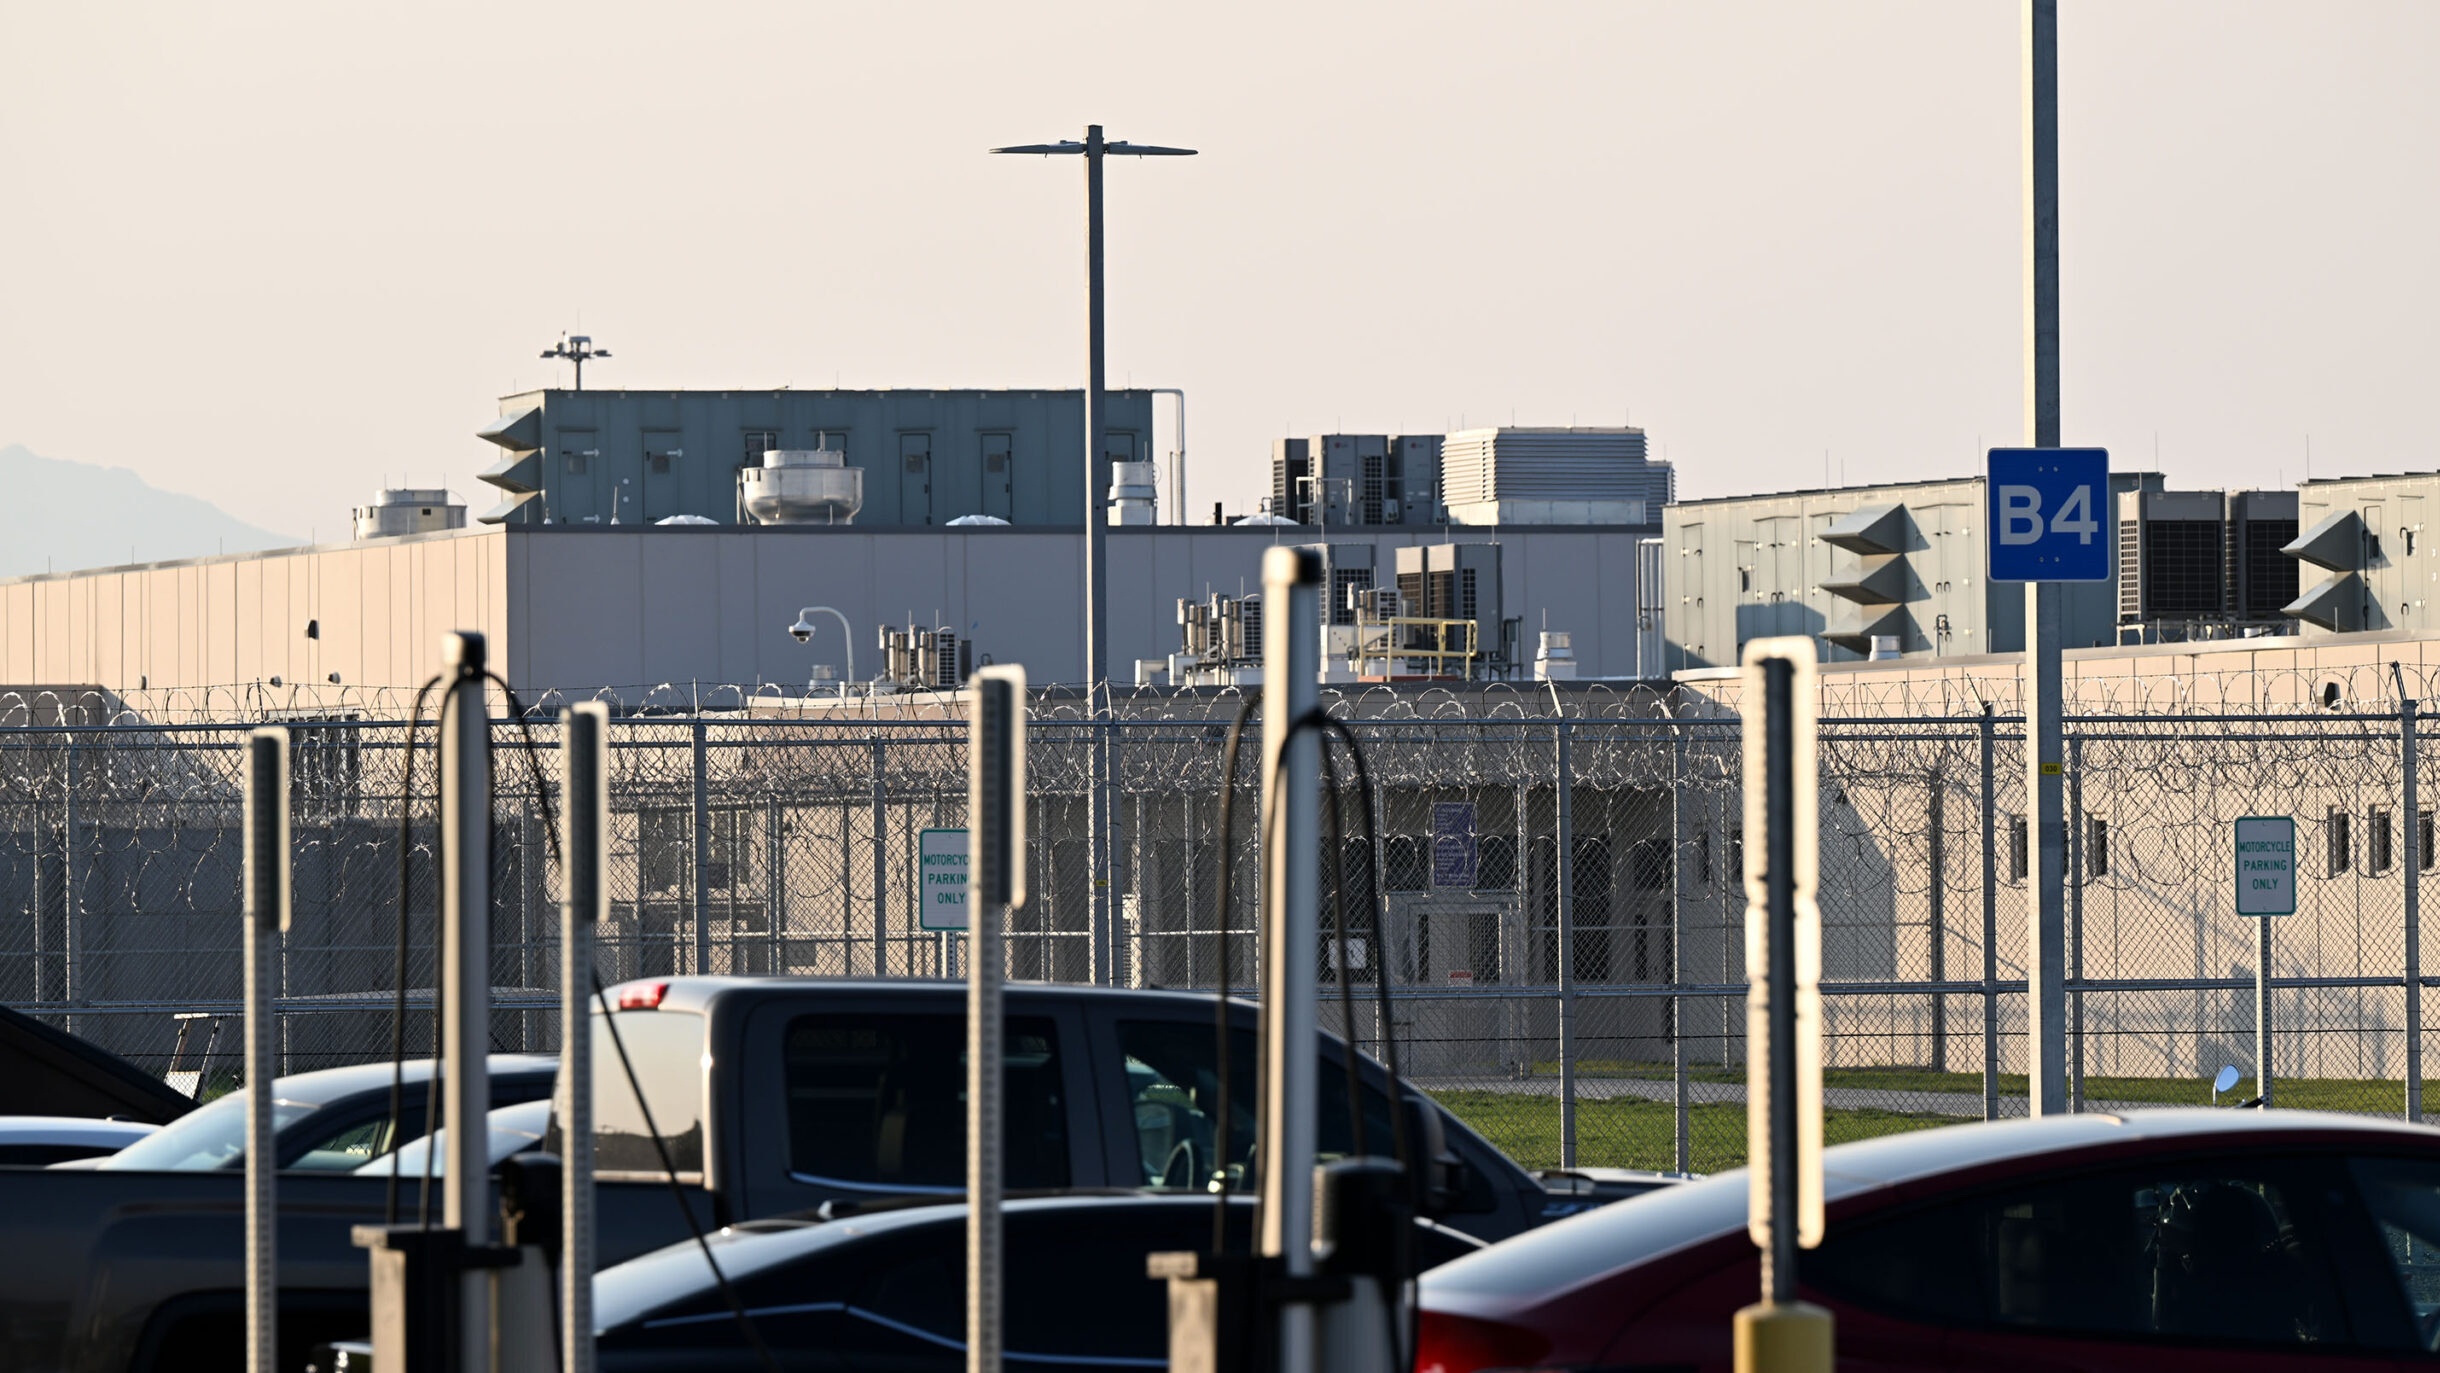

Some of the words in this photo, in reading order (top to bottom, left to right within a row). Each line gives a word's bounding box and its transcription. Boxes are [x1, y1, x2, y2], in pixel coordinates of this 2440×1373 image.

[1999, 485, 2099, 545] B4
[2239, 841, 2291, 852] MOTORCYCLE
[924, 854, 970, 865] MOTORCYC
[2244, 860, 2287, 871] PARKING
[928, 873, 967, 884] PARKIN
[2252, 878, 2278, 890] ONLY
[937, 892, 965, 904] ONLY
